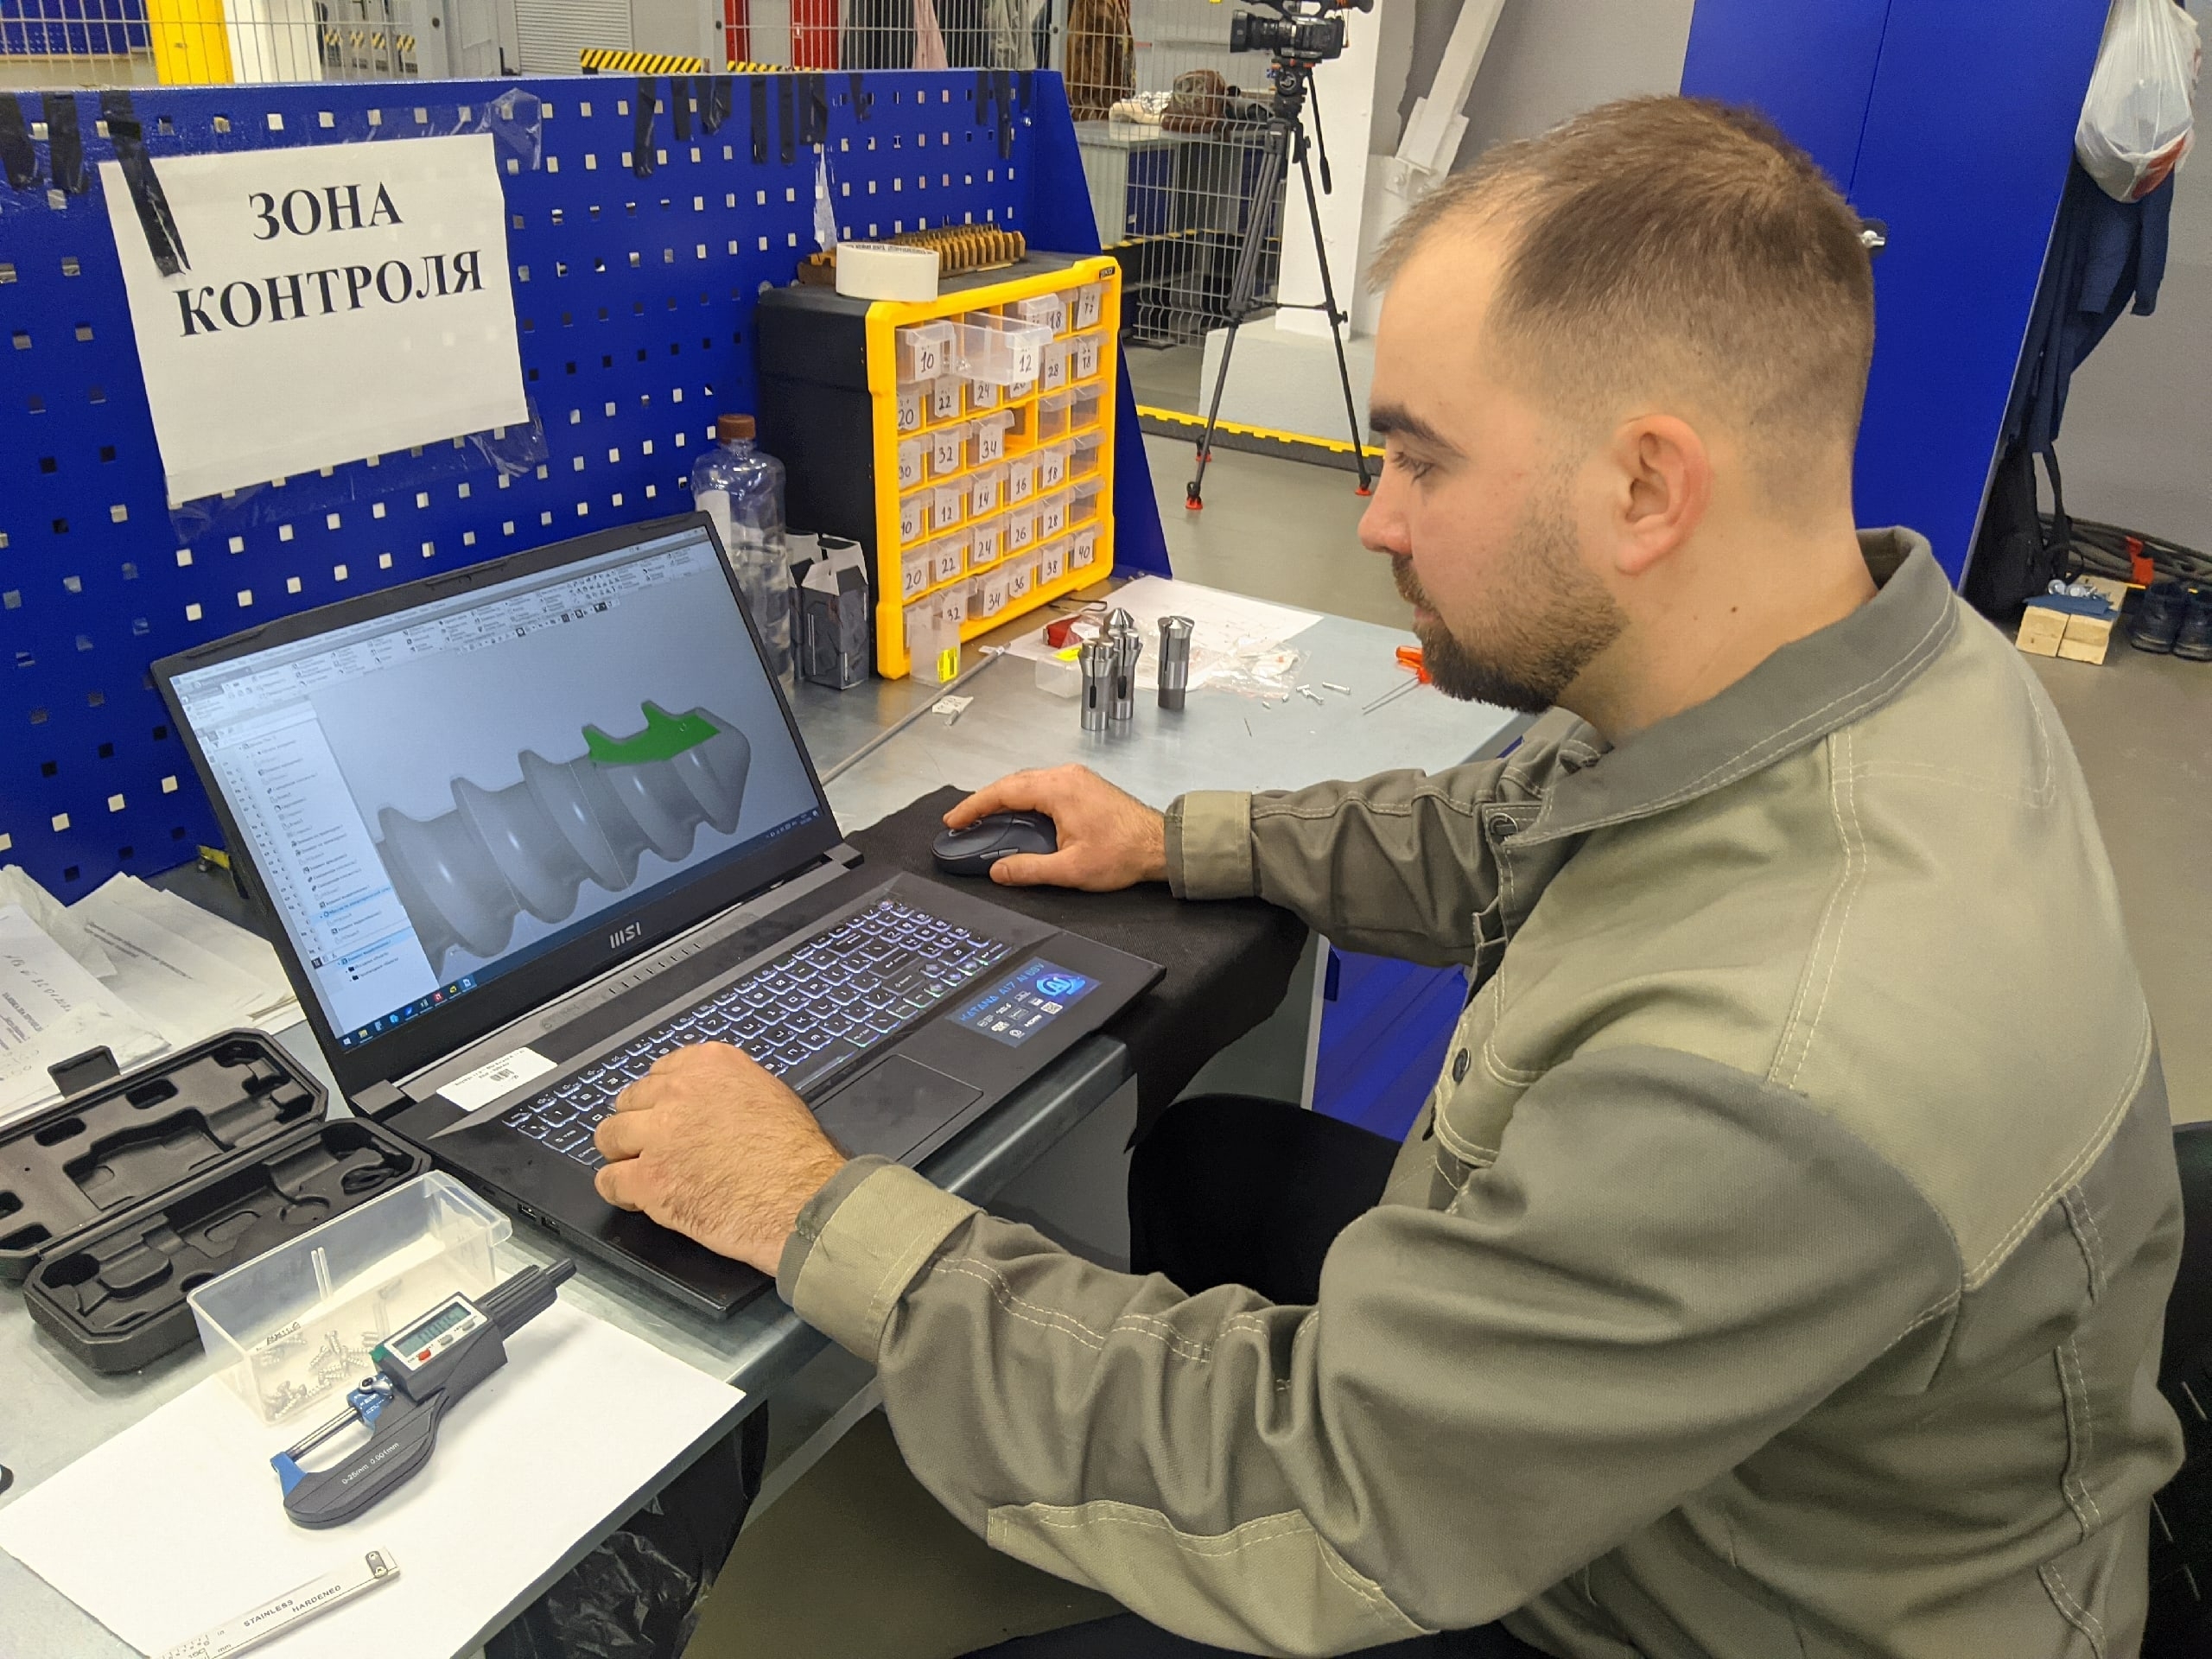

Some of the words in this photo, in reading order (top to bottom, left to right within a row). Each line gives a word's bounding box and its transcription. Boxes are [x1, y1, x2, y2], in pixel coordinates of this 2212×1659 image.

[248, 181, 404, 240] ЗОНА
[174, 250, 486, 337] КОНТРОЛЯ
[920, 351, 934, 373] 10
[1019, 354, 1032, 373] 12
[1047, 363, 1059, 378] 28
[976, 384, 989, 400] 24
[938, 395, 951, 410] 22
[898, 409, 914, 427] 20
[938, 446, 953, 464] 32
[982, 440, 997, 460] 34
[1047, 467, 1058, 483] 18
[1015, 478, 1027, 494] 16
[978, 491, 989, 509] 14
[941, 506, 952, 523] 12
[1047, 514, 1058, 530] 28
[1014, 526, 1027, 543] 26
[977, 538, 992, 558] 24
[1078, 544, 1090, 560] 40
[941, 557, 957, 574] 22
[1046, 560, 1058, 576] 38
[905, 569, 922, 591] 20
[1013, 575, 1025, 592] 36
[988, 592, 1001, 612] 34
[947, 607, 961, 621] 32
[609, 921, 641, 949] MSI
[960, 995, 1000, 1021] KATANA
[291, 1585, 341, 1613] HARDENED
[243, 1599, 294, 1627] STAINLESS
